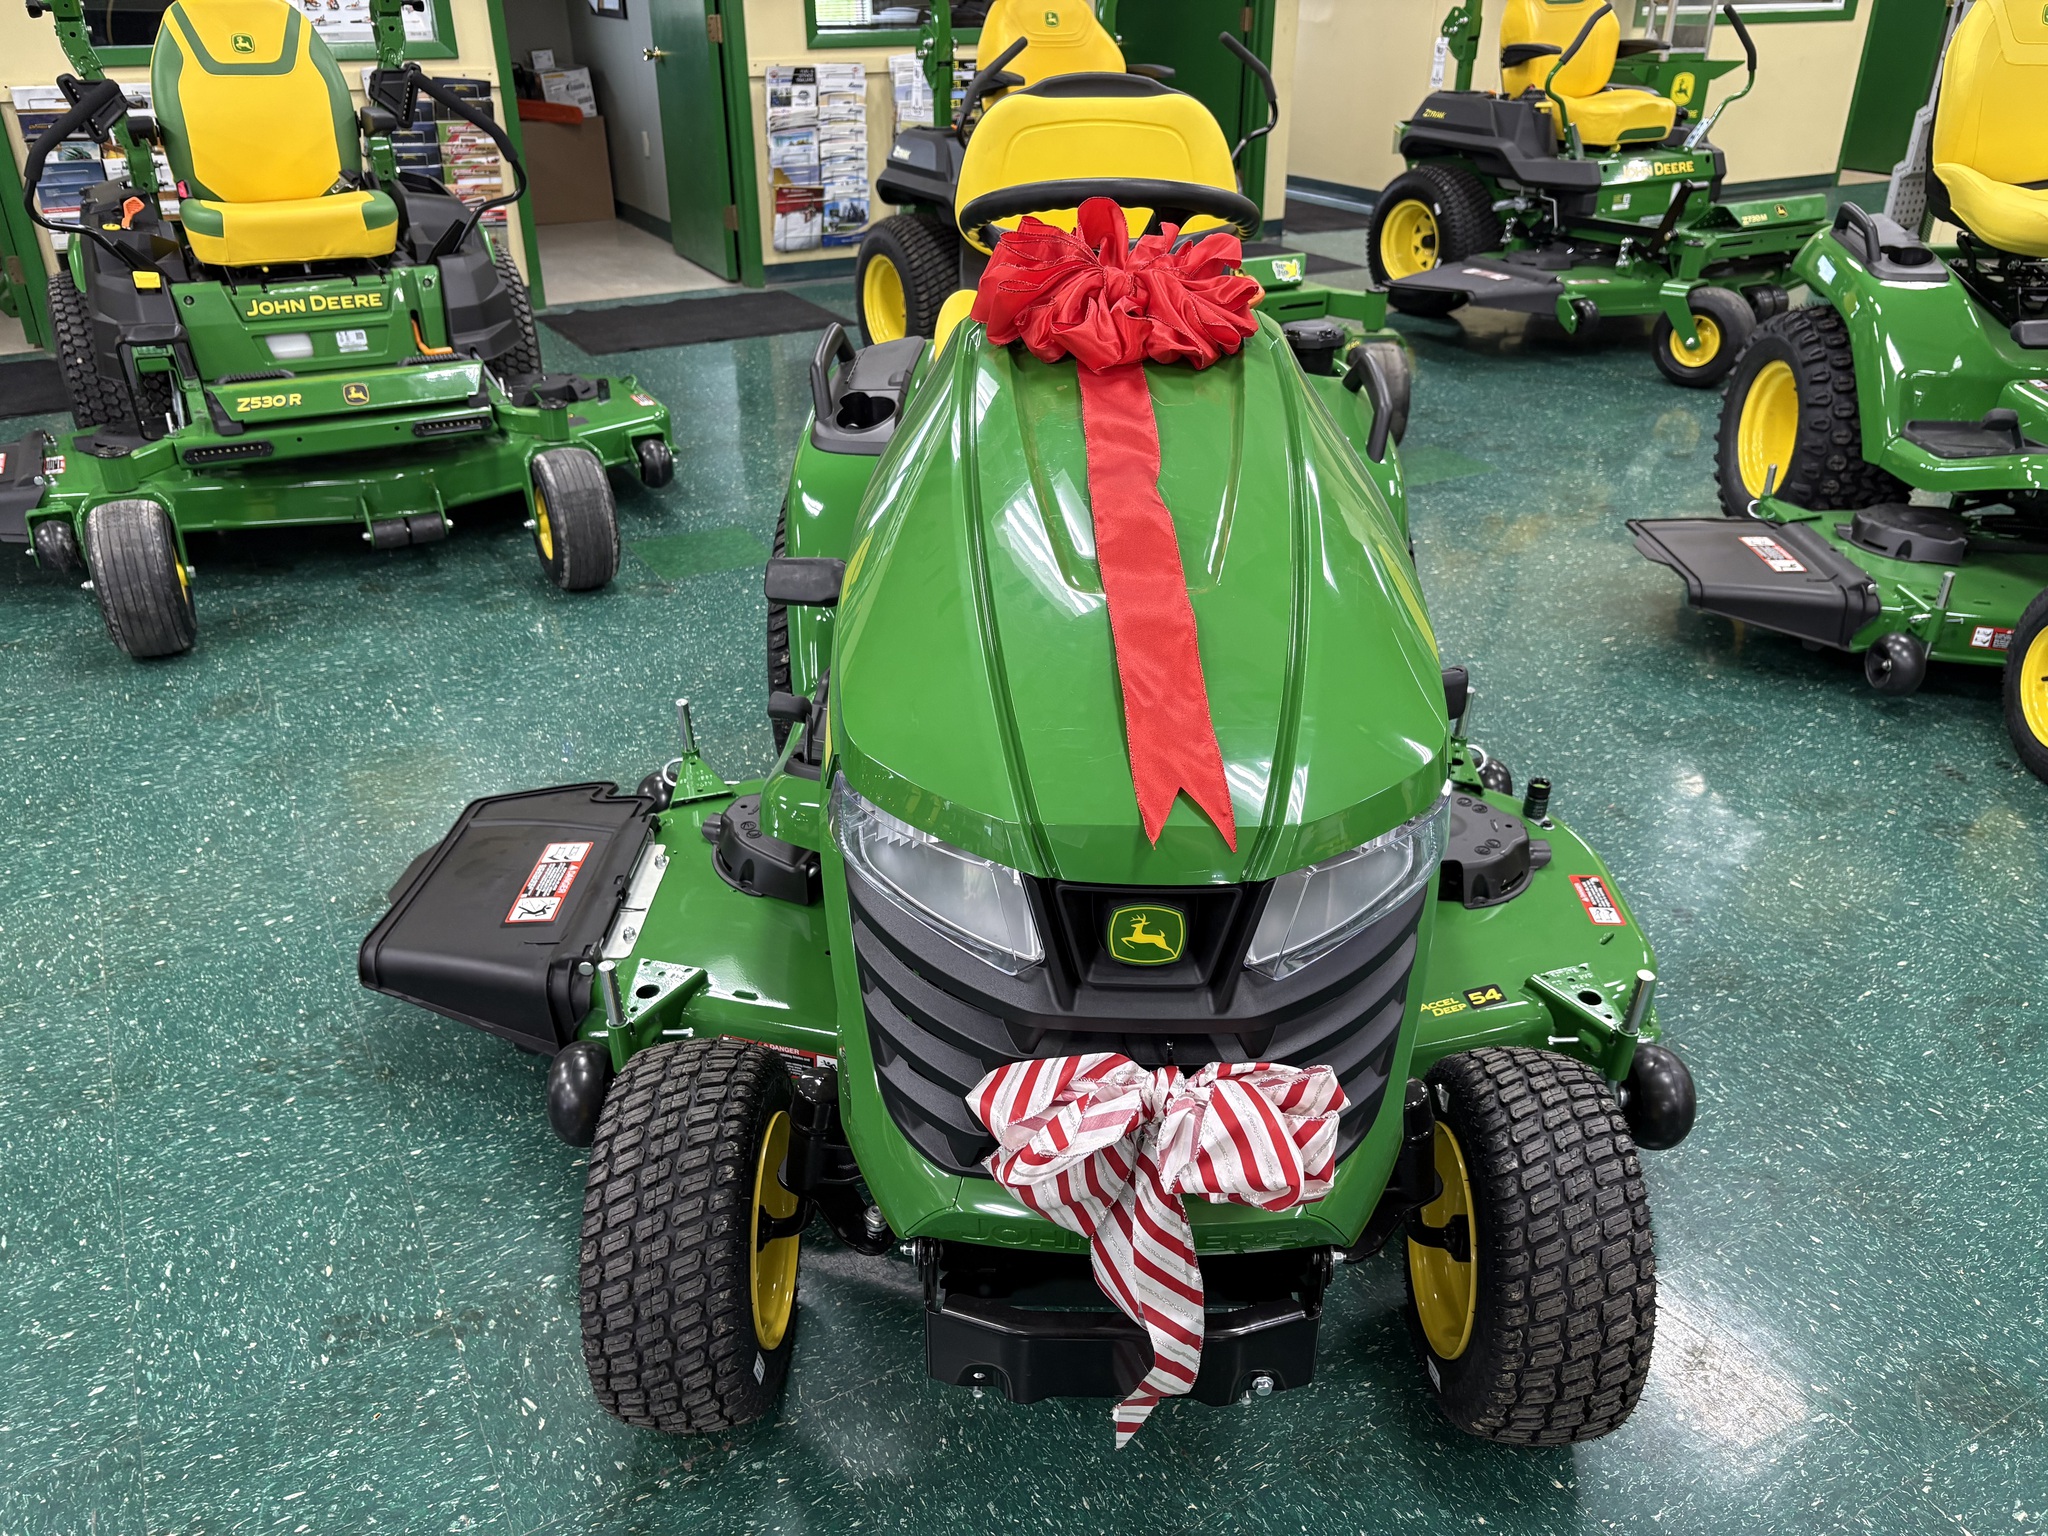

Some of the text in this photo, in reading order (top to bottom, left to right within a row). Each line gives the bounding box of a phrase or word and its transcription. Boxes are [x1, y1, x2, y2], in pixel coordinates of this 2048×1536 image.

[1623, 161, 1694, 177] JOHN DEERE
[247, 293, 383, 316] JOHN DEERE
[237, 394, 302, 412] Z530 R
[1468, 988, 1502, 1004] 54
[1421, 998, 1459, 1012] ACCEL
[1433, 1004, 1466, 1016] DEEP
[770, 1044, 800, 1055] DANGER
